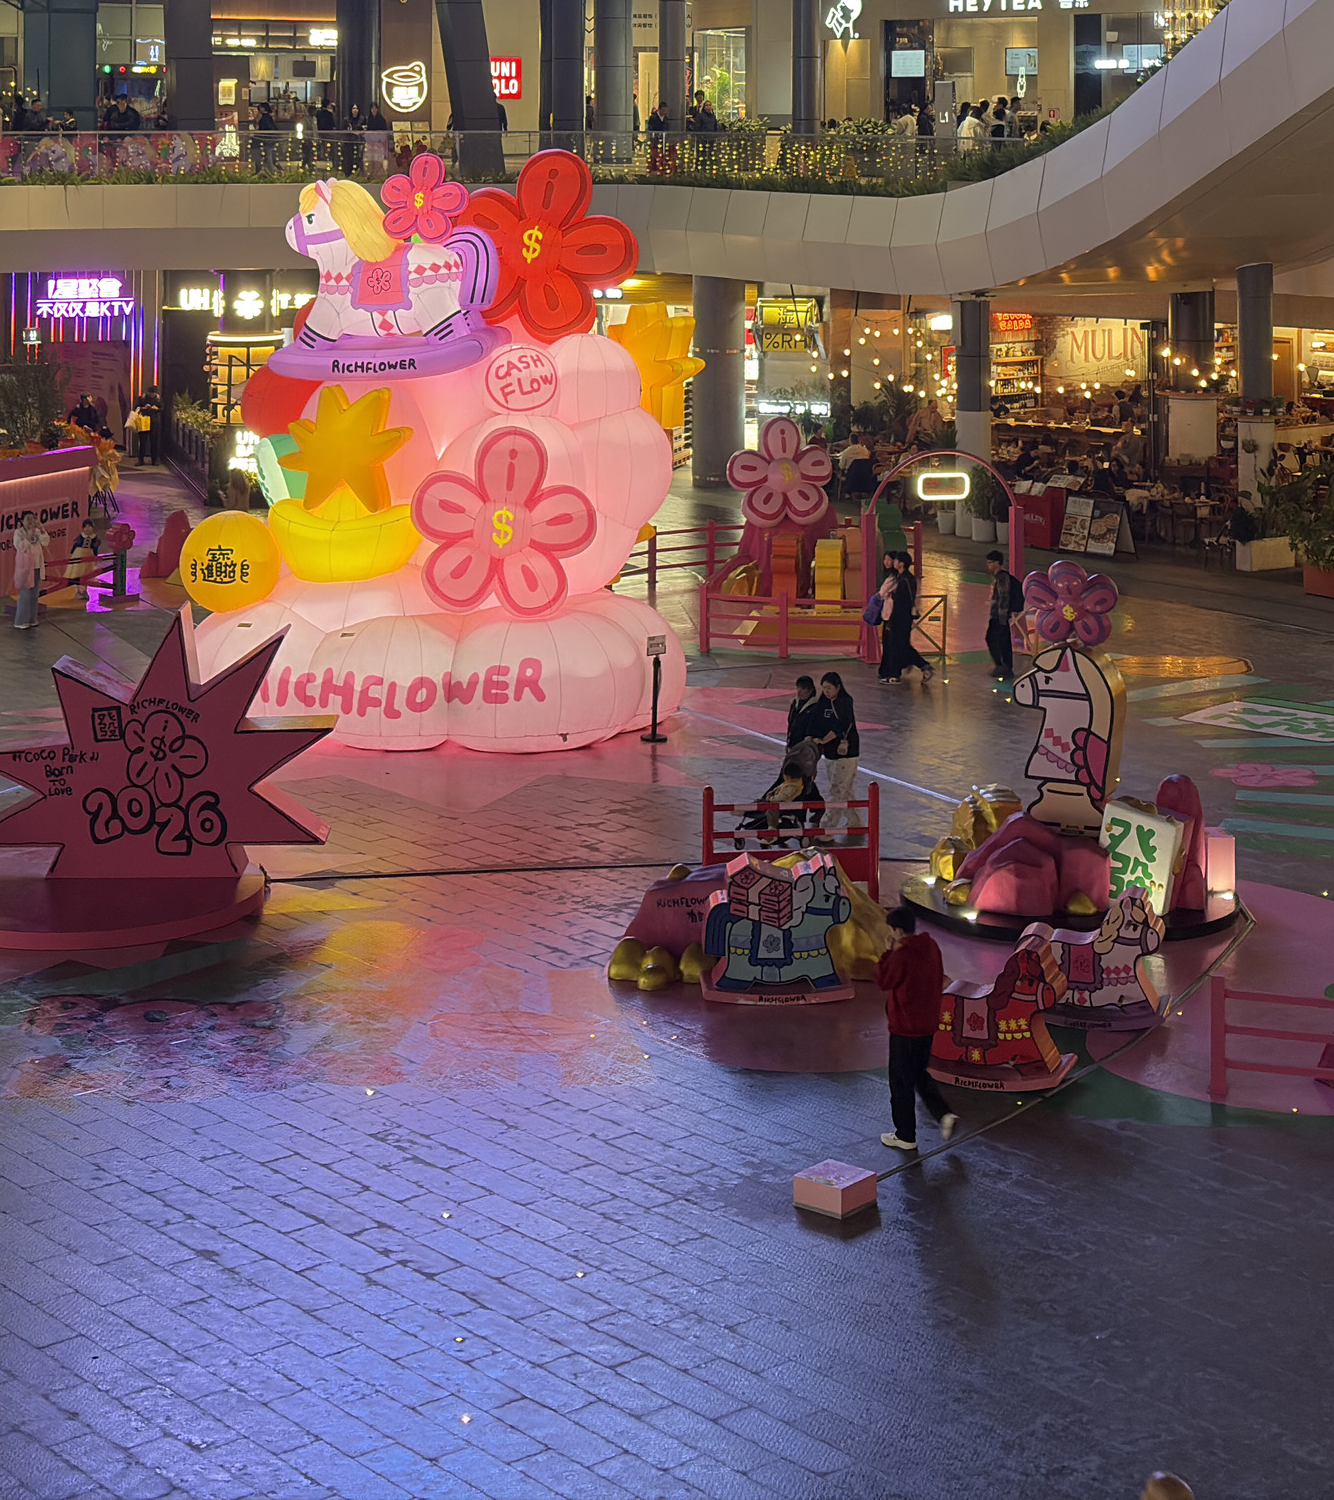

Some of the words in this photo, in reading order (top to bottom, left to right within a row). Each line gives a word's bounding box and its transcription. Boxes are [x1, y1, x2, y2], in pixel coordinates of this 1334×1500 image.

[490, 61, 517, 78] UNI
[331, 357, 418, 374] RICHFLOWER
[495, 354, 545, 381] CASH
[499, 373, 554, 405] FLOW
[261, 657, 547, 720] ICHFLOWER
[128, 698, 201, 724] RICHFLOWER
[81, 786, 228, 857] 2026
[953, 1075, 1006, 1091] RICHFLOWER
